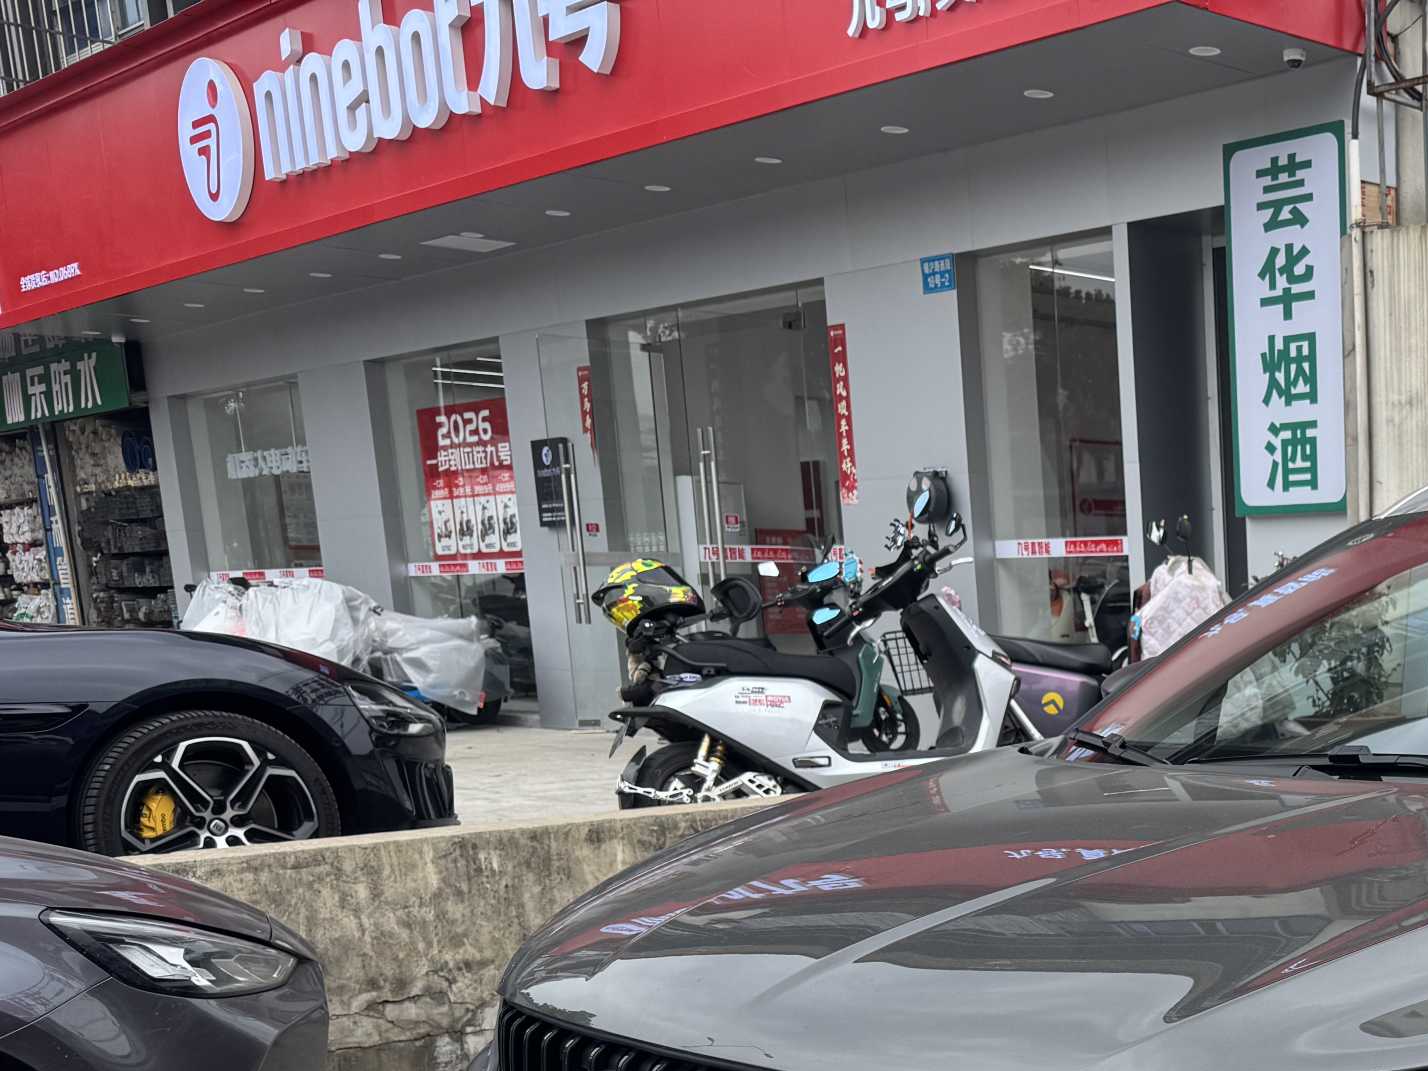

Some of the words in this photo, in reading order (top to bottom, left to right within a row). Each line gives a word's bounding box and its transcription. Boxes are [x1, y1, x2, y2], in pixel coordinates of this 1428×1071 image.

[253, 0, 483, 182] ninebot
[1255, 151, 1319, 494] 芸华烟酒
[435, 409, 492, 446] 2026
